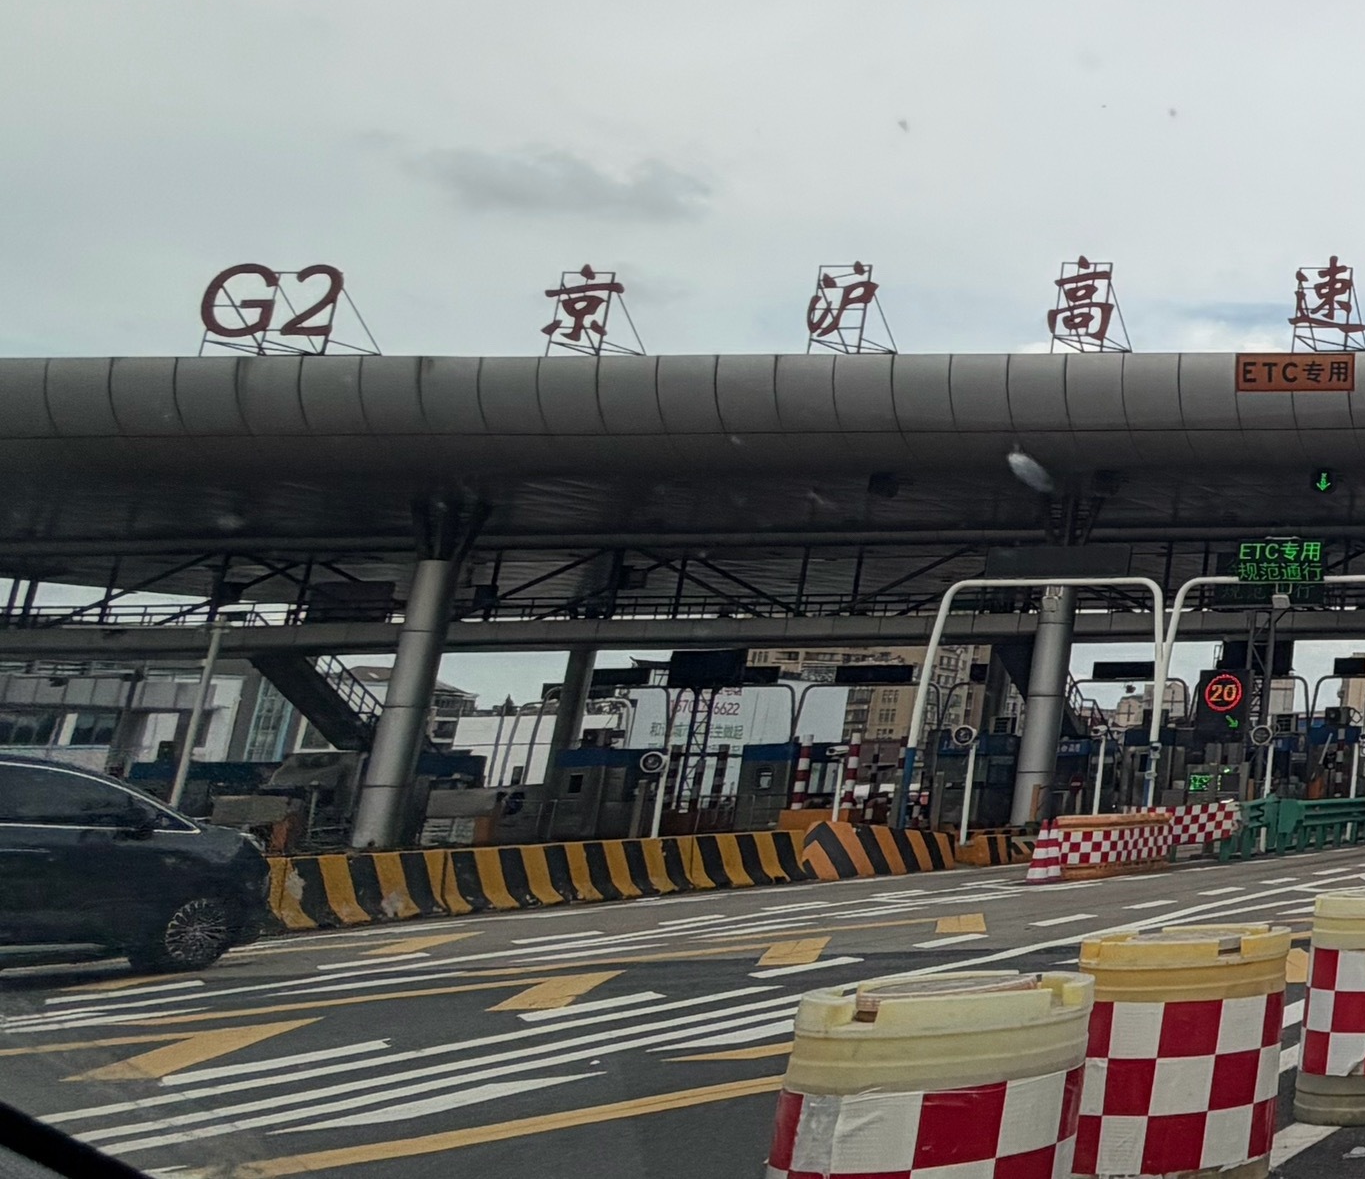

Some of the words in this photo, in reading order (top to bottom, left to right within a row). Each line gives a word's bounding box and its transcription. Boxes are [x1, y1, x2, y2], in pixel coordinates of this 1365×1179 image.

[200, 263, 344, 338] G2
[1241, 360, 1350, 387] ETC专用
[1239, 542, 1321, 561] ETC专用
[1238, 562, 1322, 581] 规范通行
[1210, 684, 1237, 702] 20
